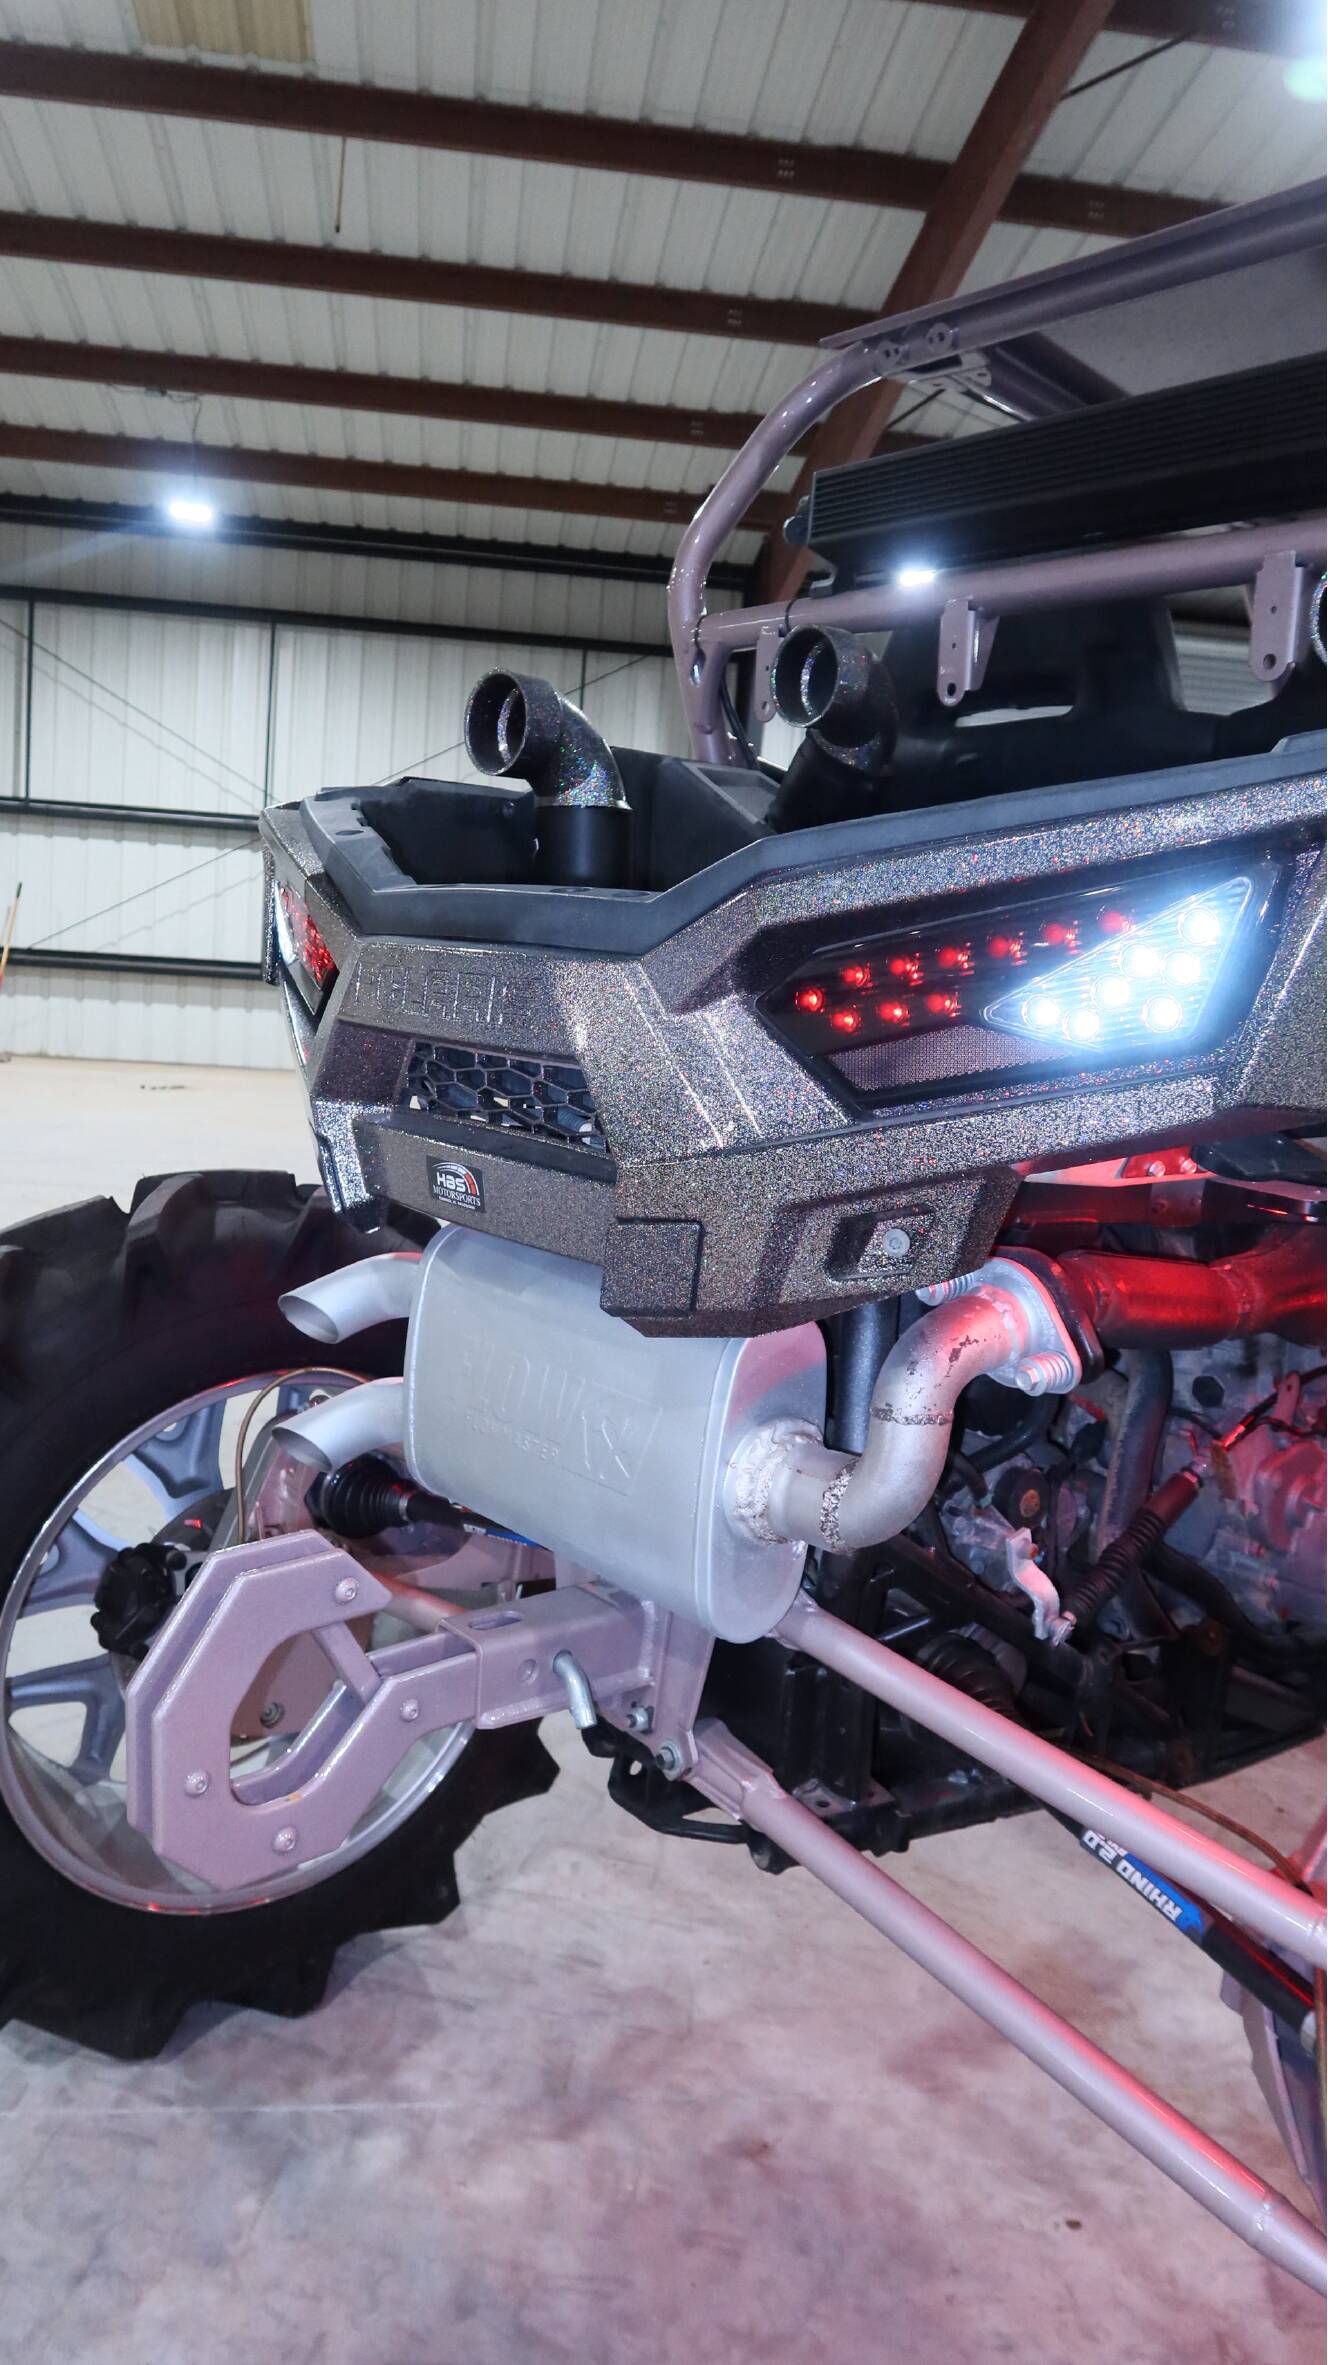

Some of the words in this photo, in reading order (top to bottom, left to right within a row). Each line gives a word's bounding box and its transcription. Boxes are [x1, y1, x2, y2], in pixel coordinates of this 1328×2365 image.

[354, 961, 545, 1026] POLARIS
[432, 1184, 481, 1207] MOTORSPORTS
[1115, 1858, 1183, 1921] RHINO
